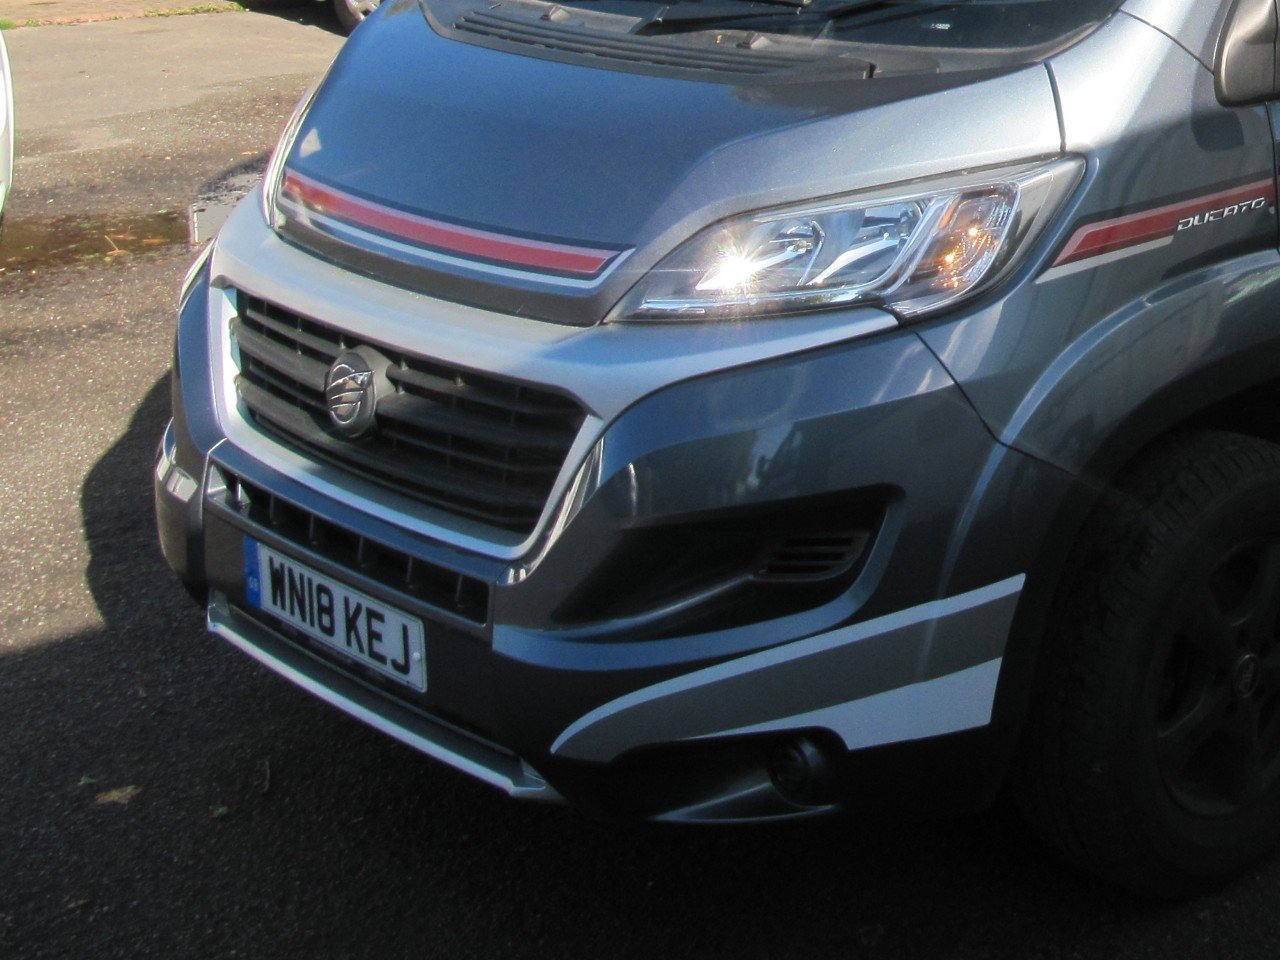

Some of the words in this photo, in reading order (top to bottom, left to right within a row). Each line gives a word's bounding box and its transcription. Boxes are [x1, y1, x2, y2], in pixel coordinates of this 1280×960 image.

[1177, 197, 1266, 231] DUCATO
[268, 557, 336, 638] WN18
[344, 595, 412, 676] KEJ
